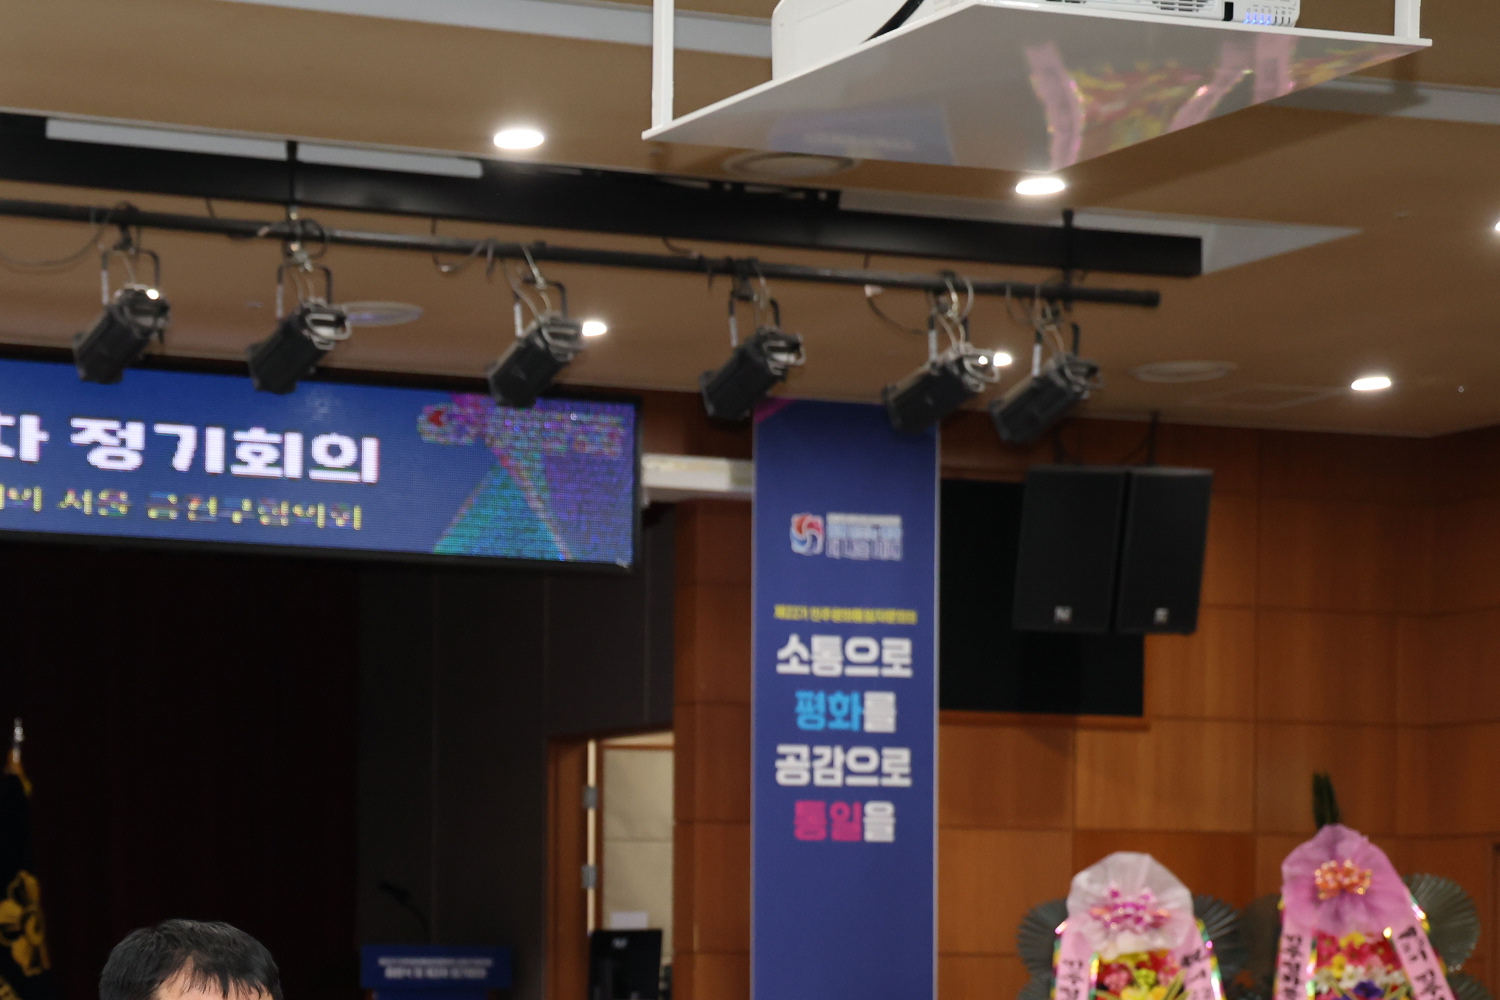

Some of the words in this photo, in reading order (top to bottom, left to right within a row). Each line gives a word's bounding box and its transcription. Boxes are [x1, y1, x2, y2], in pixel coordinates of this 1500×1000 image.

[70, 417, 379, 483] 정기회의
[776, 633, 913, 678] 소통으로
[794, 690, 897, 734] 평화를
[775, 743, 912, 788] 공감으로
[794, 800, 896, 843] 통일을
